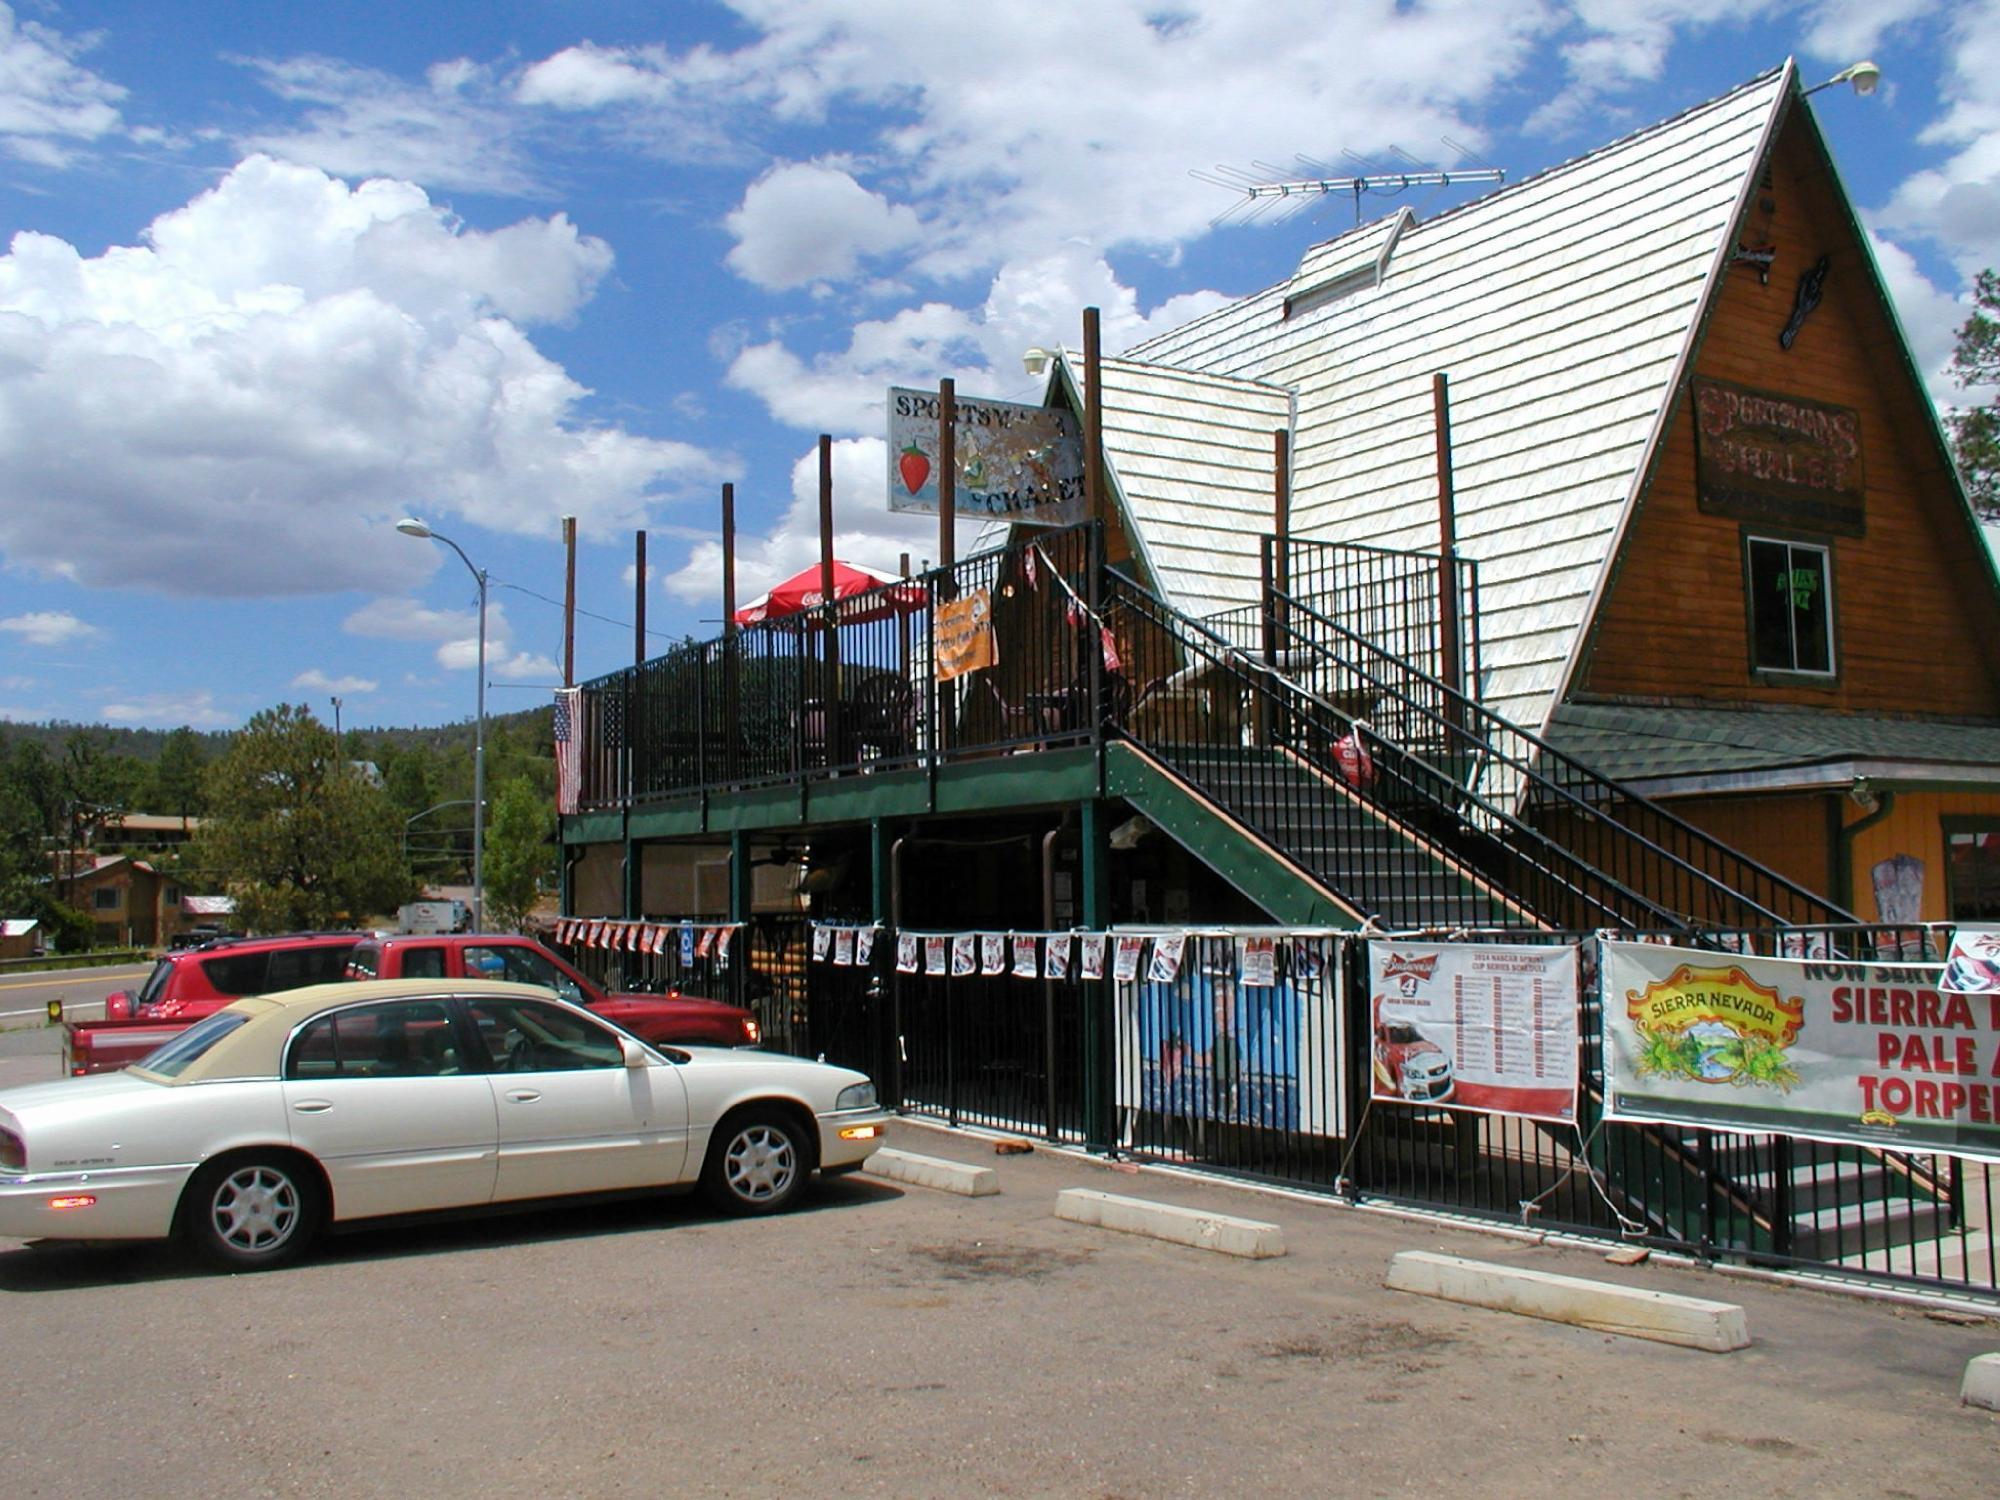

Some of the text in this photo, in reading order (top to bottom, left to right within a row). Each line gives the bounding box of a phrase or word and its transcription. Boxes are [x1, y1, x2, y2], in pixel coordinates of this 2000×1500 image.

[1400, 977, 1416, 998] 4
[1803, 963, 1866, 982] NOW
[1650, 991, 1776, 1026] SIERRA NEVADA
[1831, 986, 1977, 1031] SIERRA
[1877, 1032, 1978, 1076] PALE
[1857, 1074, 2000, 1126] TORPE
